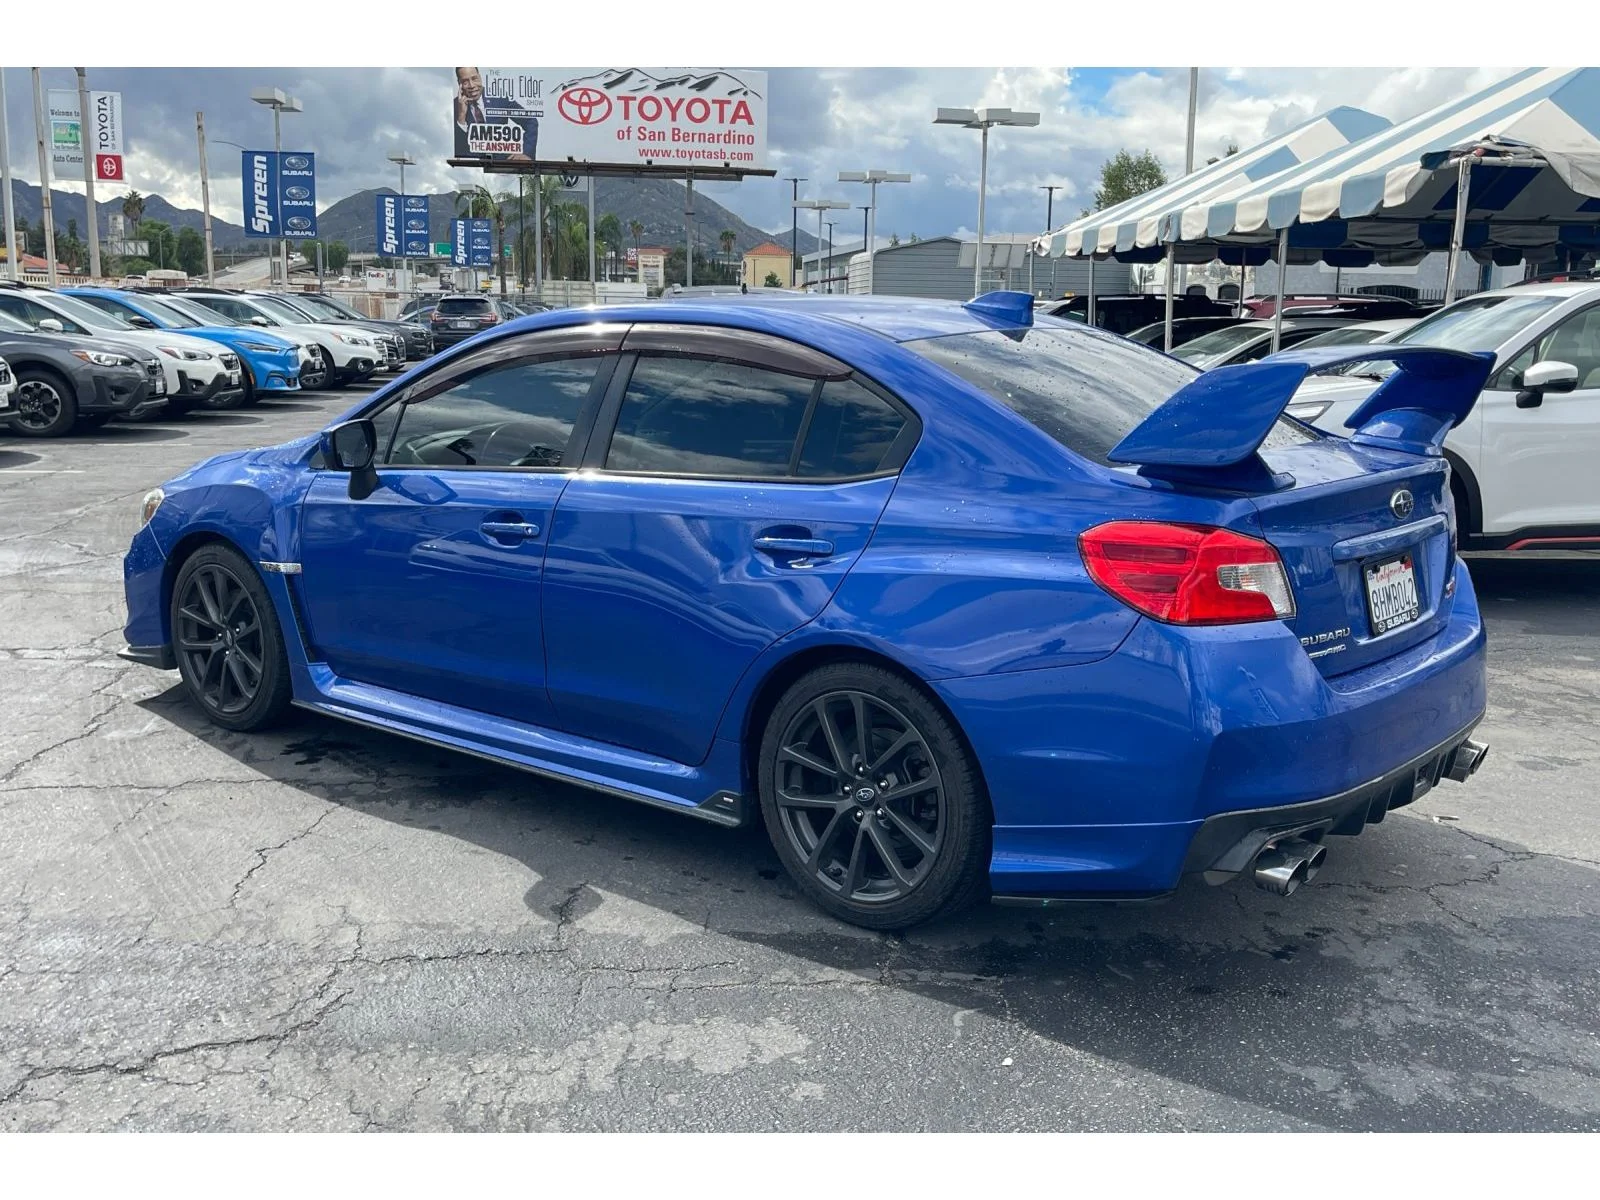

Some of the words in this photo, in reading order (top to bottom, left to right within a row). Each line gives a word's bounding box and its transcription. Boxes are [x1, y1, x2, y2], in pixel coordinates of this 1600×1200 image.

[485, 75, 514, 100] Larry
[519, 75, 544, 98] Elder
[50, 108, 73, 117] Welcome
[98, 96, 109, 150] TOYOTA
[616, 95, 755, 126] TOYOTA
[469, 125, 521, 142] AM590
[617, 126, 632, 141] of
[637, 126, 666, 142] San
[671, 127, 755, 145] Bernardino
[638, 148, 754, 161] www.toyotasb.com
[251, 155, 273, 234] Spreen
[383, 197, 399, 254] Spreen
[455, 220, 468, 265] Spreen
[1371, 577, 1417, 620] 8HMB042
[1386, 611, 1411, 629] SUBARU
[1300, 627, 1351, 646] SUBARU
